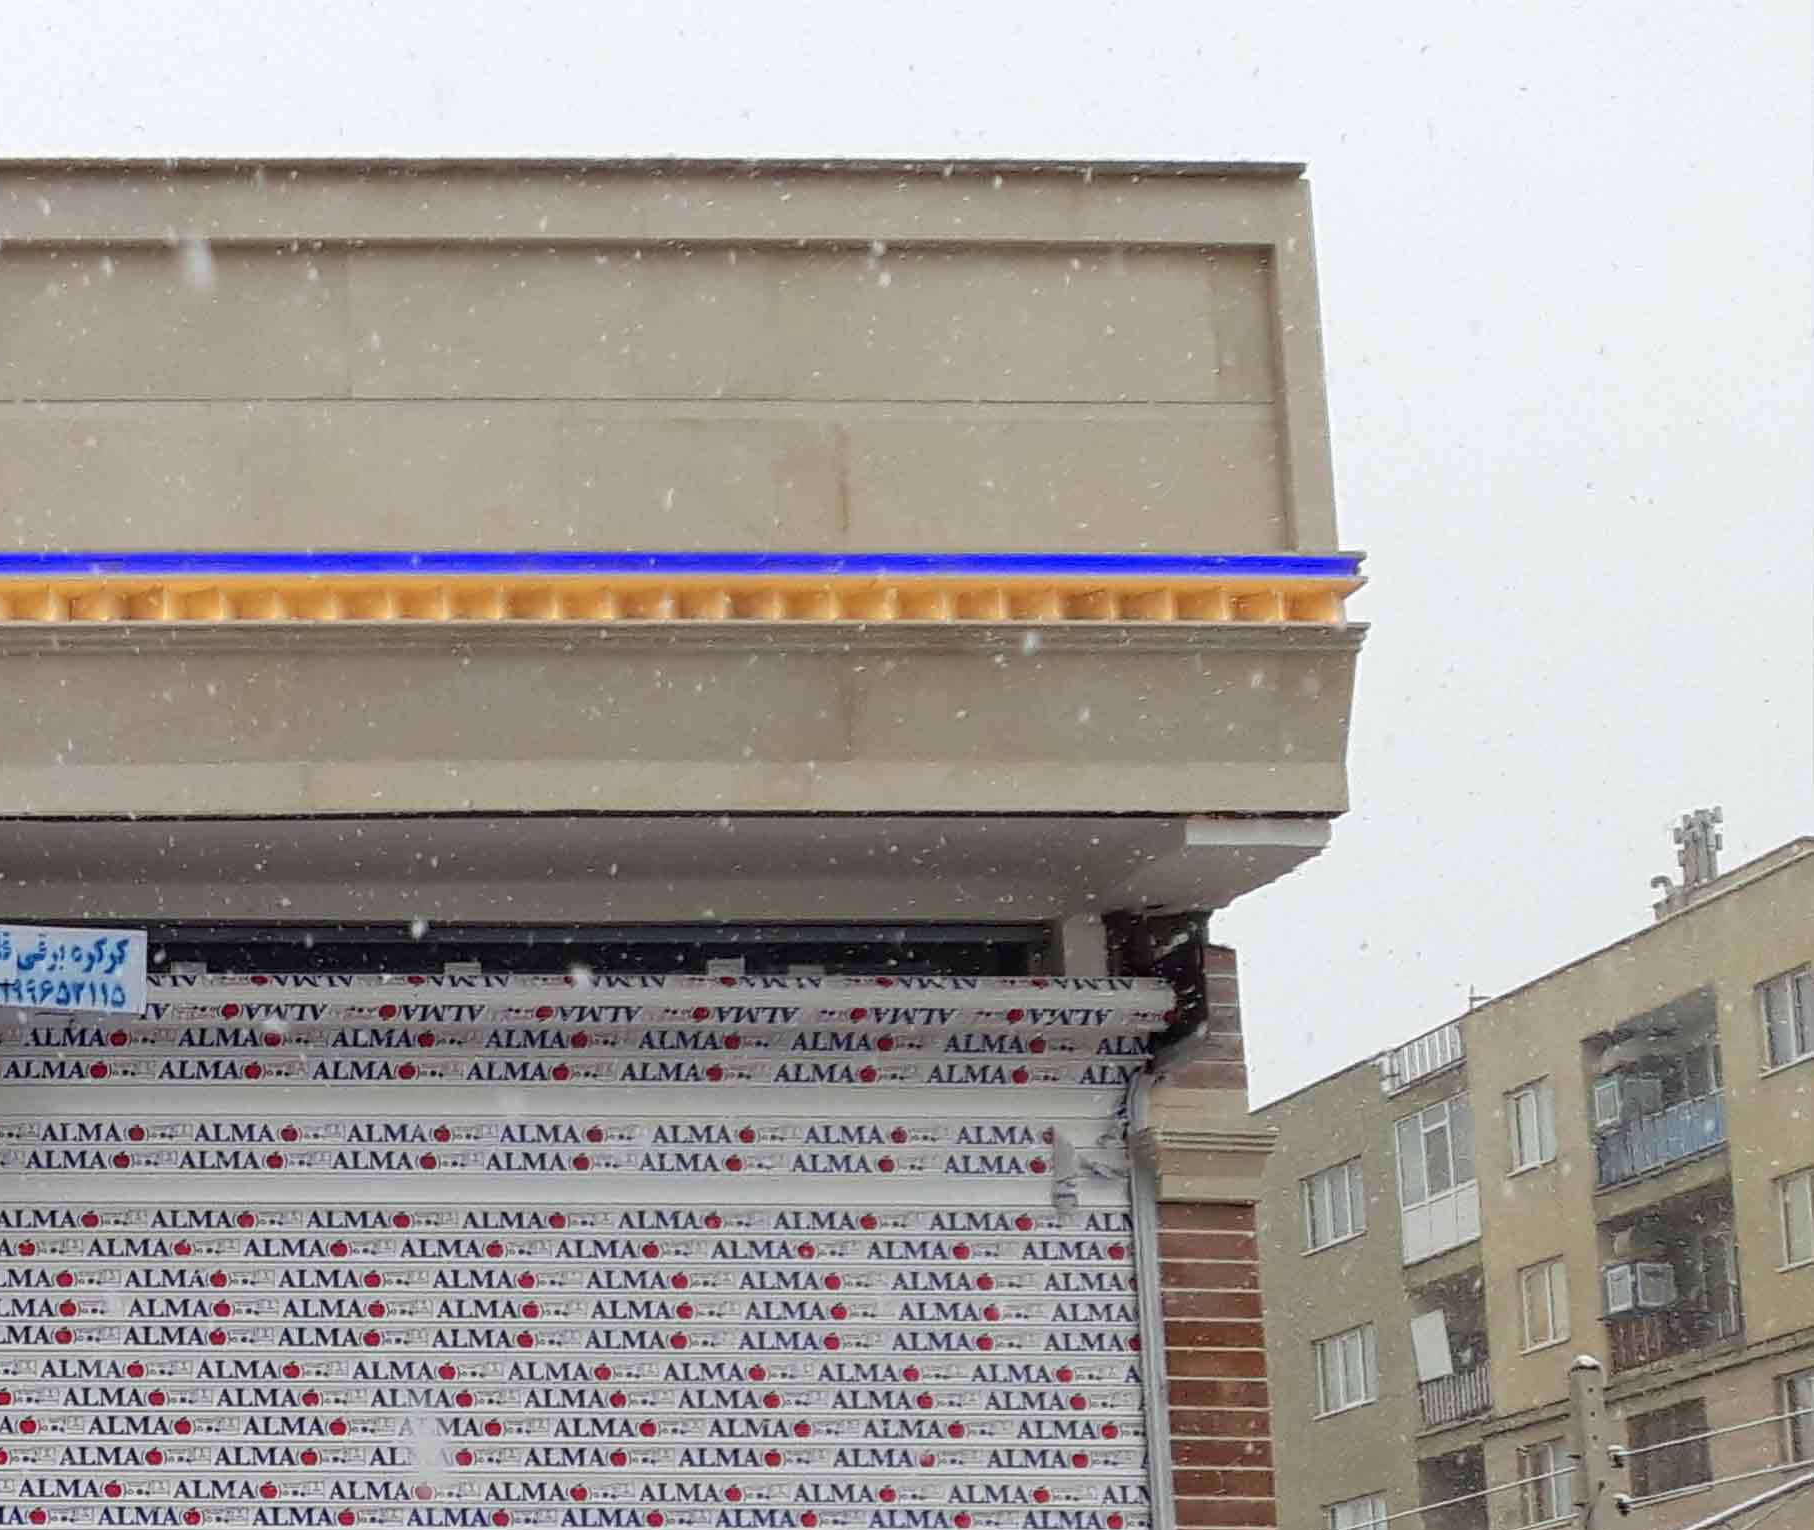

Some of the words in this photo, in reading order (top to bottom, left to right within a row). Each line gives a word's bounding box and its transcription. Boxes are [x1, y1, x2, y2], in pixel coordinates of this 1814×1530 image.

[3, 1060, 86, 1079] ALMA
[158, 1060, 239, 1080] ALMA
[312, 1060, 395, 1080] ALMA
[466, 1061, 548, 1081] ALMA
[620, 1061, 702, 1082] ALMA
[773, 1063, 855, 1084] ALMA
[926, 1063, 1006, 1085] ALMA
[128, 1298, 209, 1318] ALMA
[282, 1298, 365, 1318] ALMA
[437, 1299, 518, 1319] ALMA
[591, 1299, 672, 1320] ALMA
[745, 1300, 826, 1321] ALMA
[898, 1301, 982, 1322] ALMA
[98, 1506, 180, 1526] ALMA
[252, 1506, 333, 1527] ALMA
[406, 1507, 490, 1527] ALMA
[560, 1507, 644, 1528] ALMA
[715, 1508, 797, 1529] ALMA
[869, 1508, 950, 1529] ALMA
